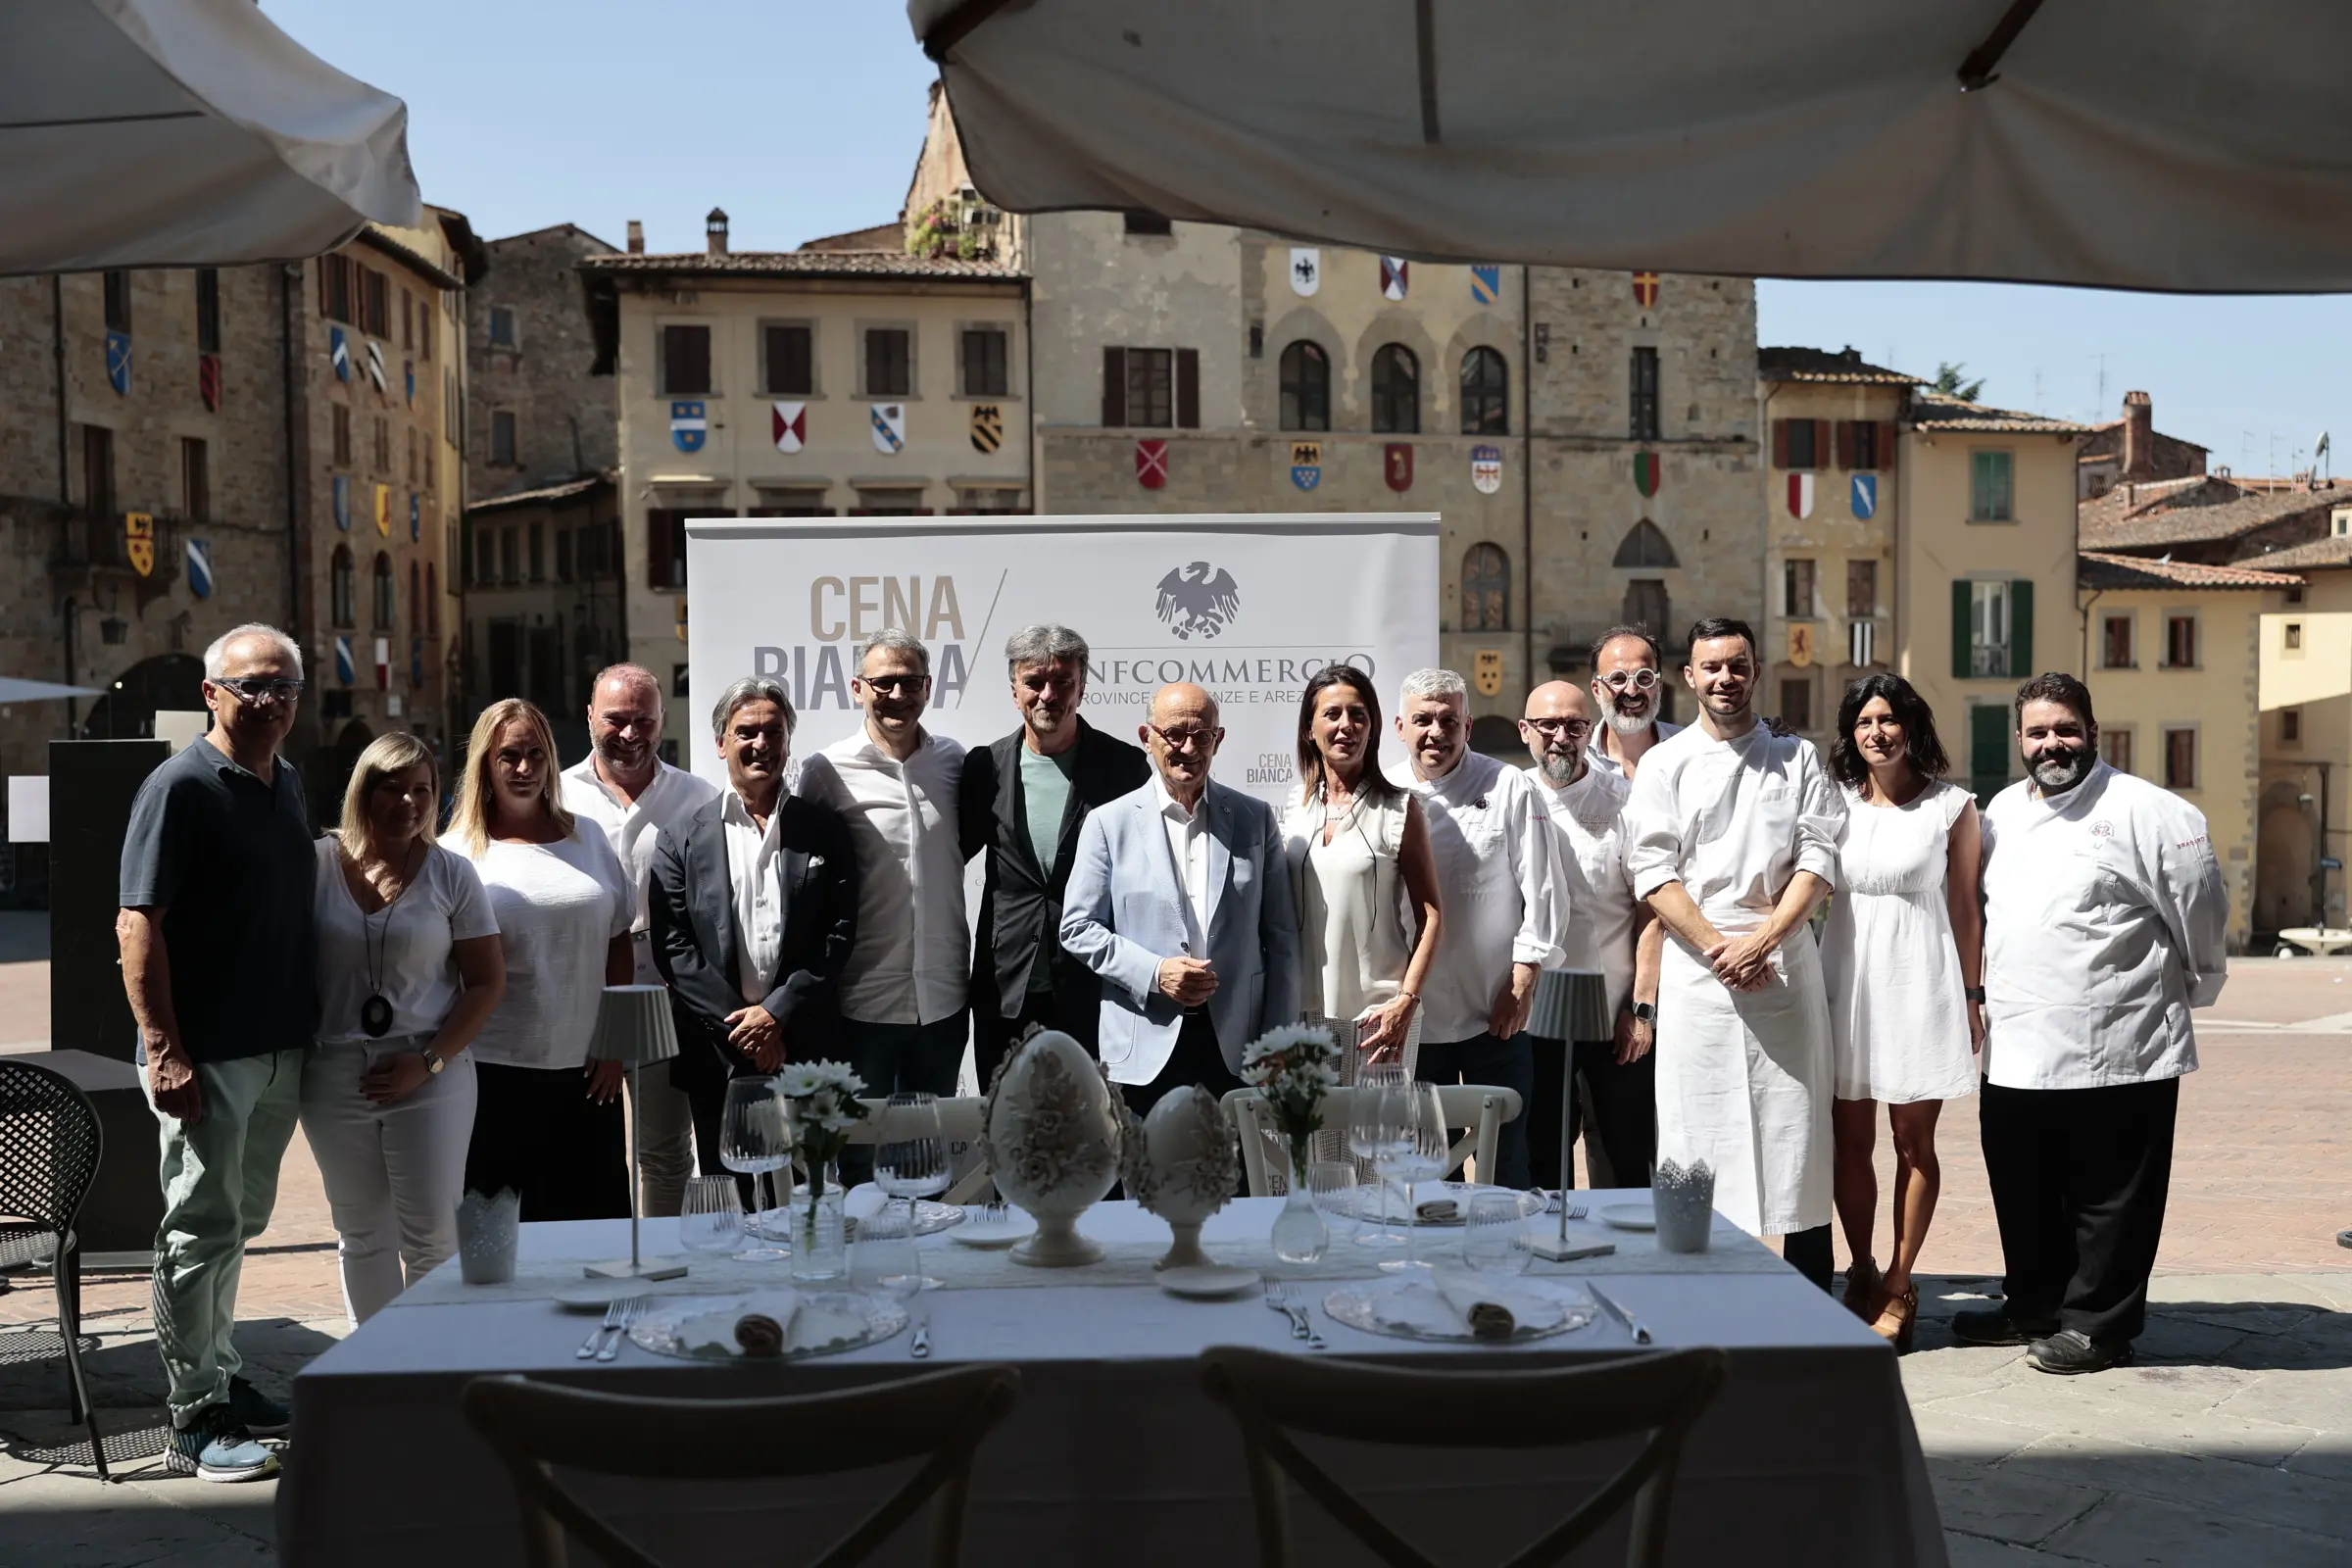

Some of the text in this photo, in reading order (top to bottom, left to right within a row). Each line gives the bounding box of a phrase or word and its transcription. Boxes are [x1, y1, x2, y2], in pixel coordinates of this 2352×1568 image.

[810, 575, 965, 642] CENA
[754, 644, 967, 710] BIAA
[1087, 654, 1376, 684] NFCOMMERCO
[1082, 692, 1151, 705] ROVINCE
[1250, 691, 1259, 704] E
[1264, 690, 1304, 704] AREZ
[1258, 753, 1293, 768] CENA
[1247, 768, 1294, 783] BIANCA
